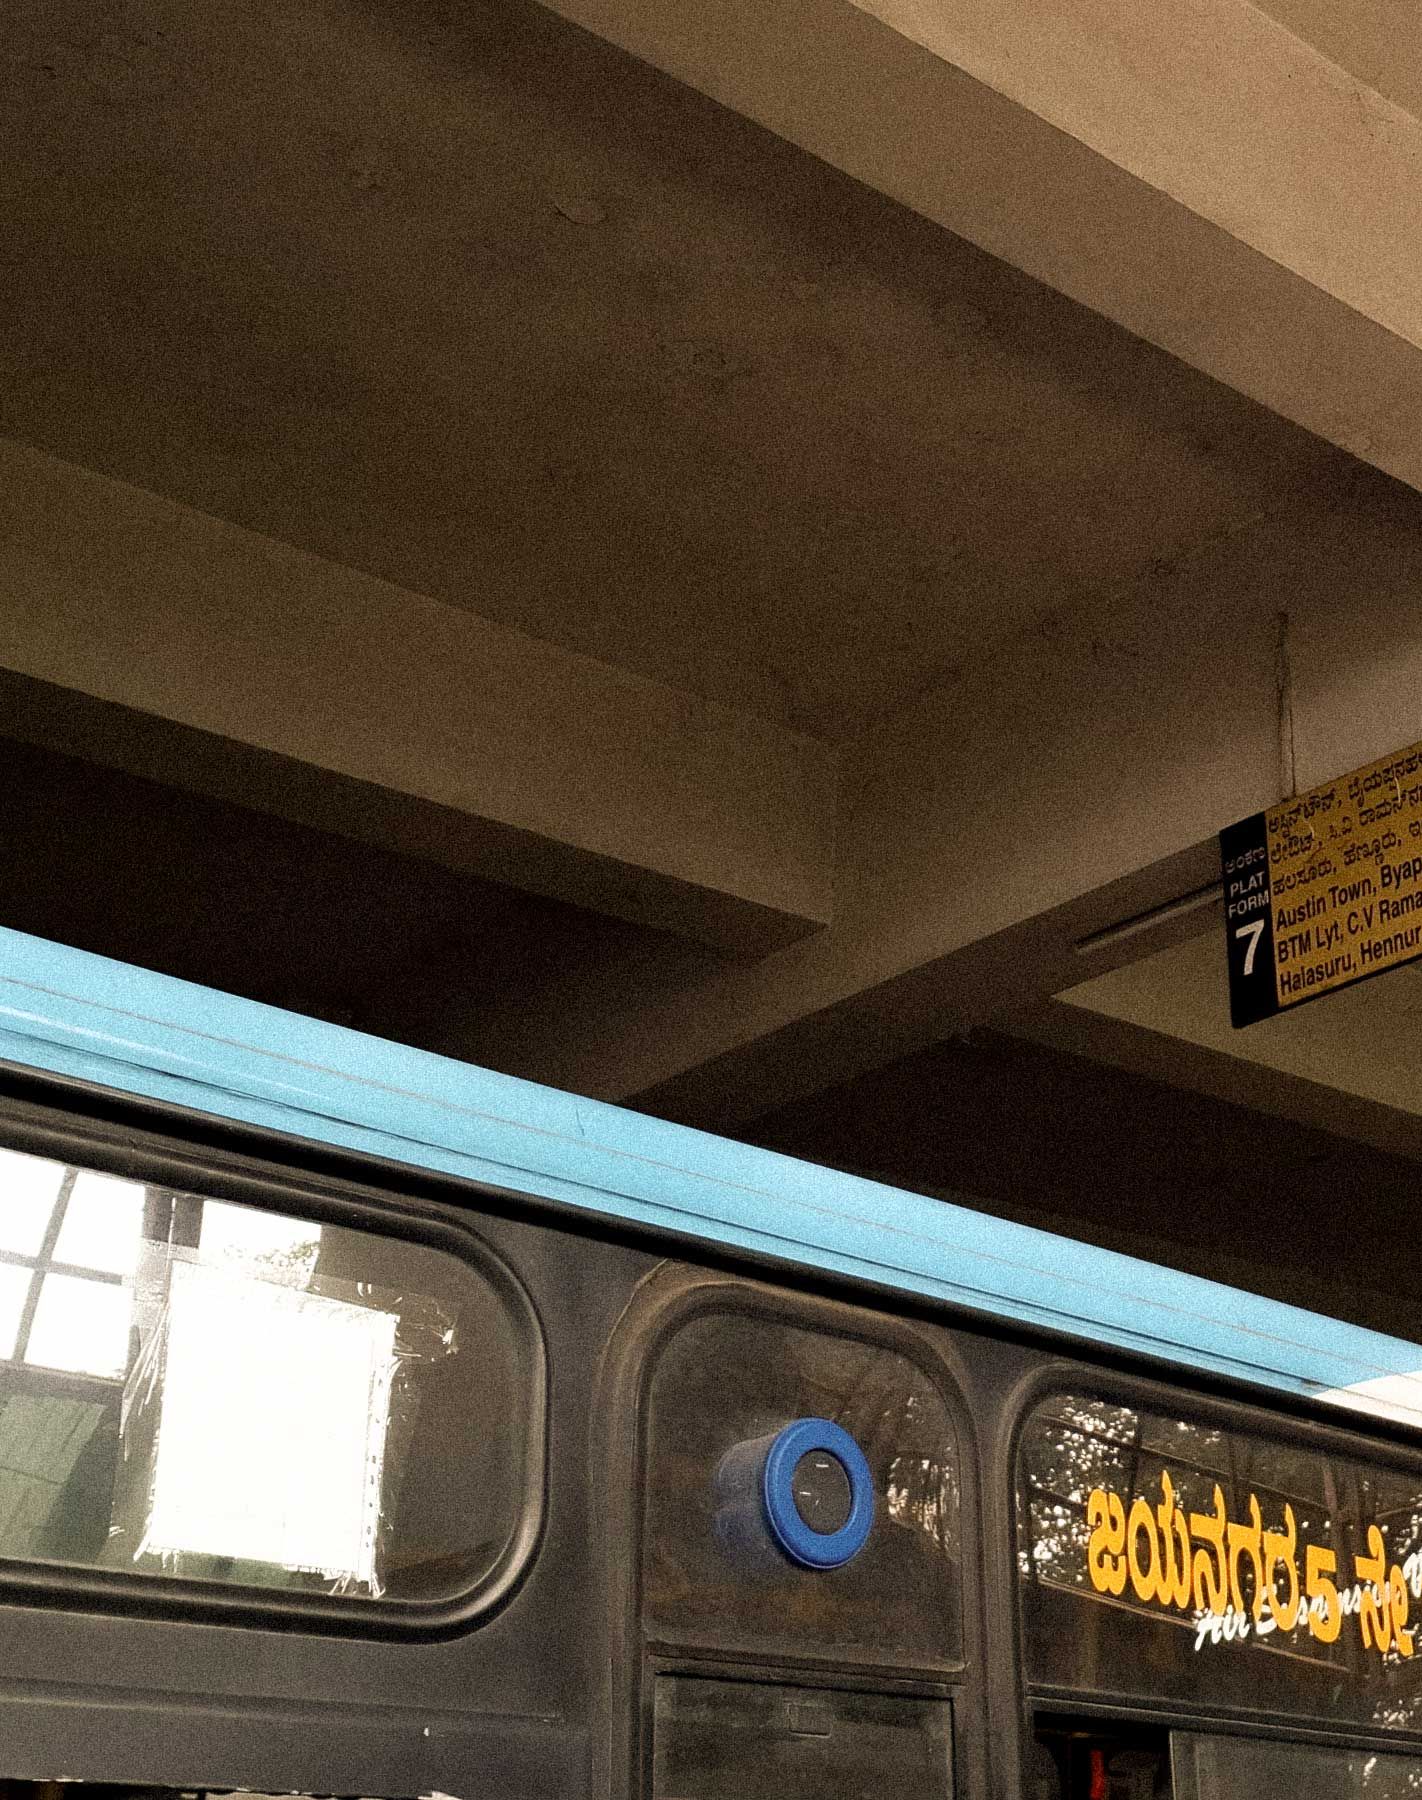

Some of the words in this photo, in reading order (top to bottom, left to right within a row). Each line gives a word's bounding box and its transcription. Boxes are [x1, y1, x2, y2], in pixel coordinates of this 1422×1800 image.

[1228, 889, 1270, 919] FORM
[1229, 870, 1266, 898] PLAT
[1276, 895, 1326, 931] Austin
[1327, 878, 1377, 908] Town,
[1235, 918, 1266, 977] 7
[1277, 929, 1311, 964] BTM
[1315, 920, 1344, 950] Lyt,
[1346, 904, 1373, 935] C.V
[1279, 953, 1357, 995] Halasuru,
[1087, 1469, 1299, 1632] ಜಯನಗರ
[1306, 1544, 1342, 1644] 5
